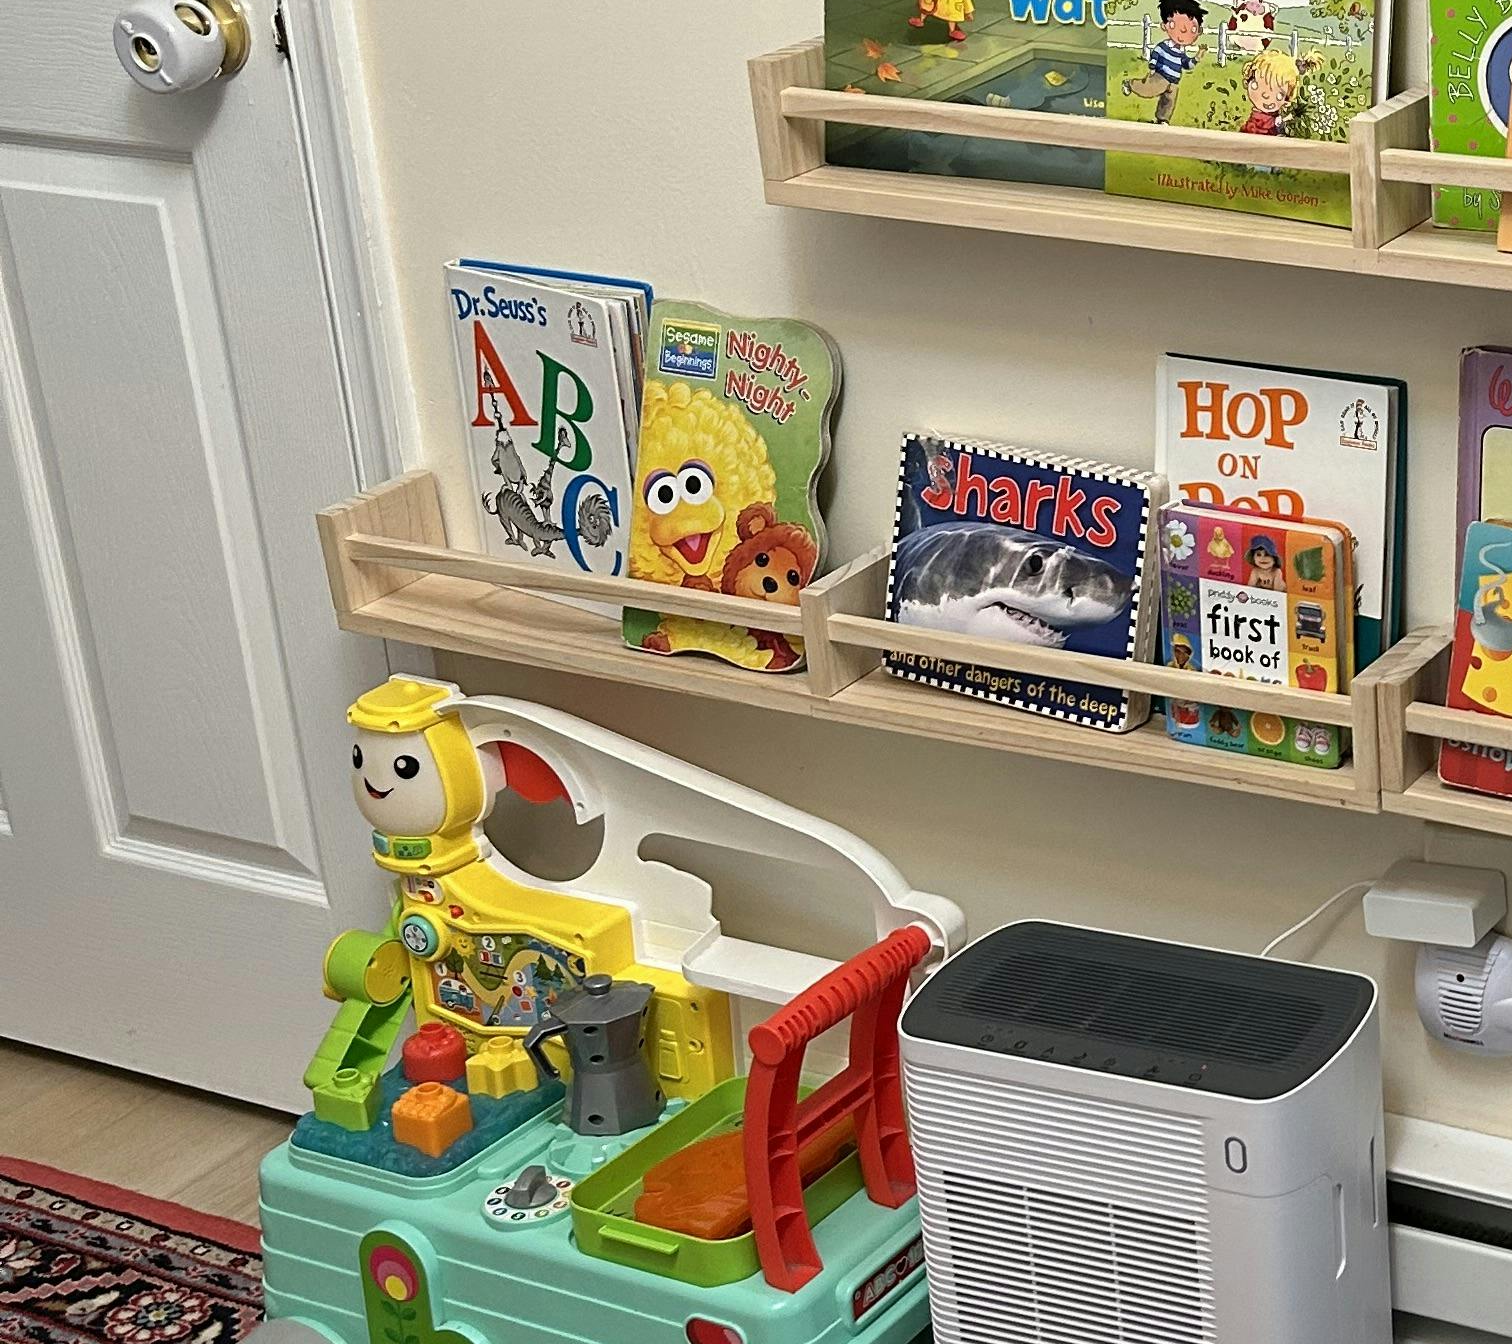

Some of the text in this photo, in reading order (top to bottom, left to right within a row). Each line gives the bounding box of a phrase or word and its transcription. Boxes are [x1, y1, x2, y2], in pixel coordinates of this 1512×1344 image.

[663, 353, 712, 372] Beginnings
[665, 325, 715, 348] Sesame
[471, 320, 539, 427] A
[724, 370, 797, 425] Night
[530, 349, 594, 472] B
[1217, 452, 1261, 480] ON
[561, 474, 620, 576] C
[920, 453, 1122, 549] Sharks
[1206, 603, 1281, 645] first
[1209, 639, 1281, 670] book of
[919, 657, 961, 678] other
[965, 664, 1021, 693] dangers
[1026, 680, 1045, 699] of
[1049, 685, 1076, 706] the
[1079, 693, 1118, 722] deep
